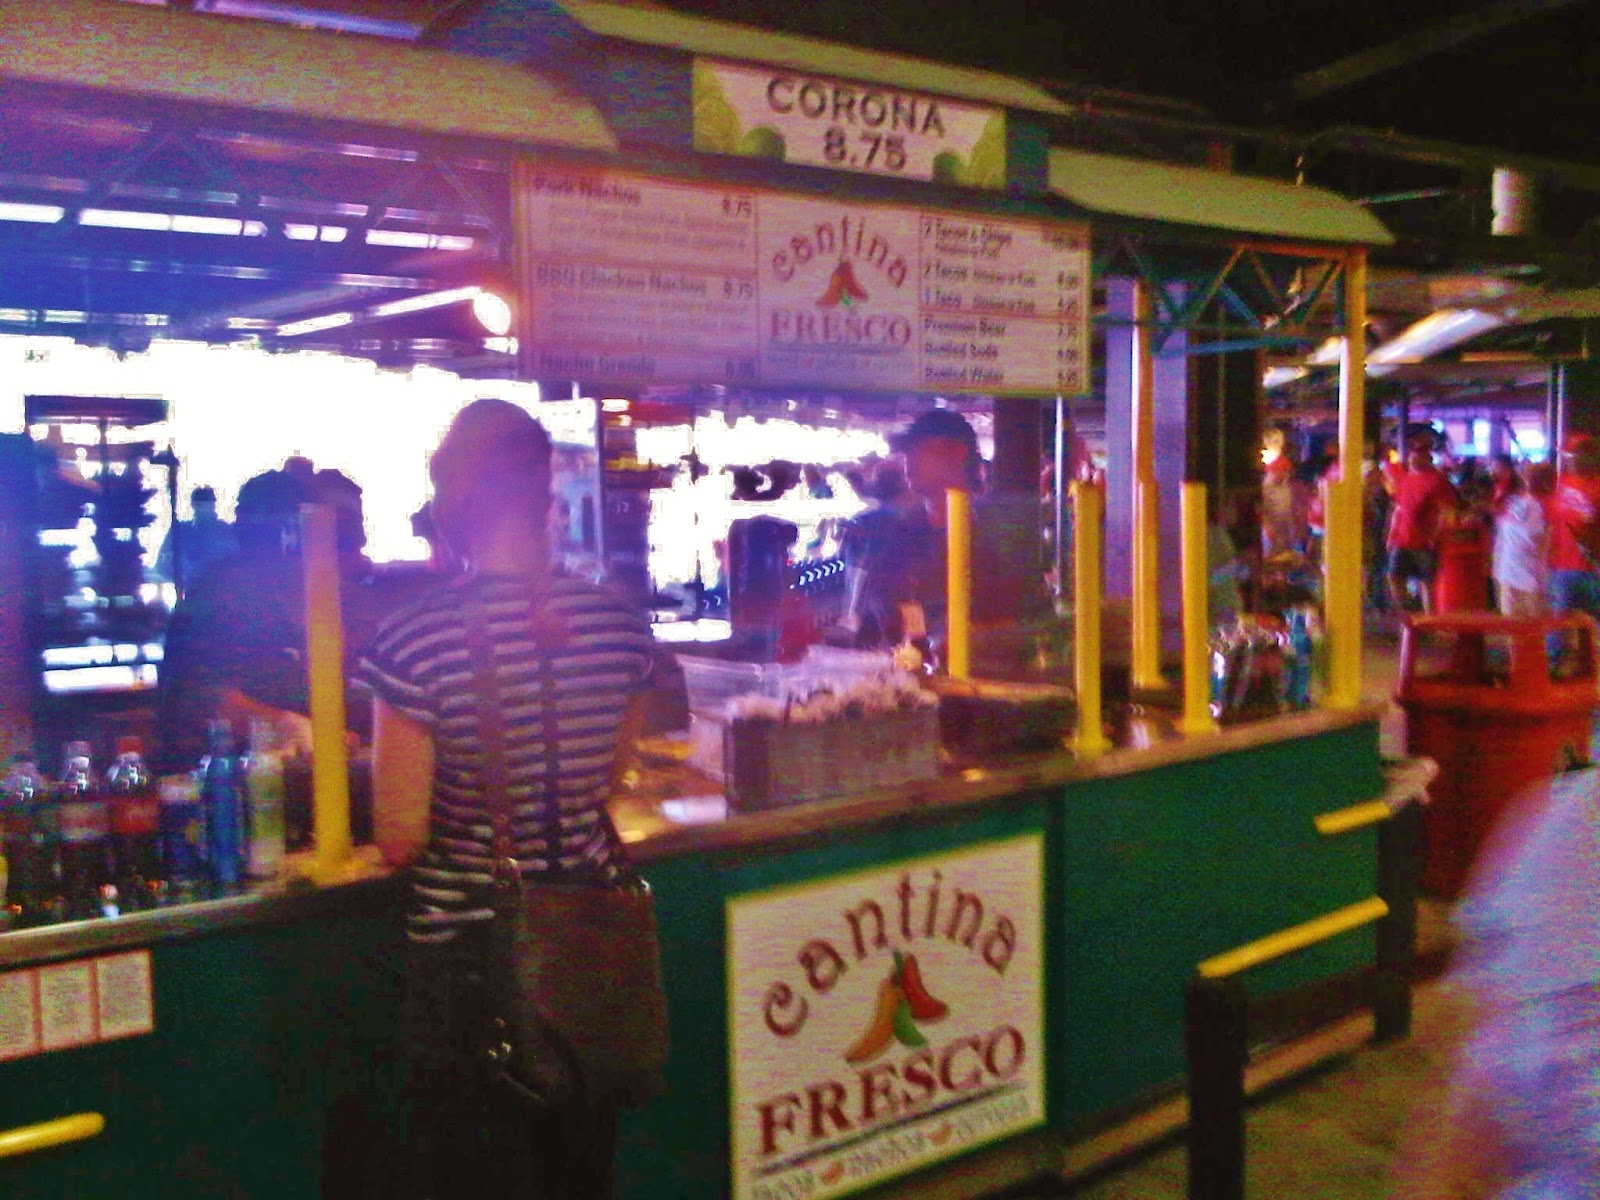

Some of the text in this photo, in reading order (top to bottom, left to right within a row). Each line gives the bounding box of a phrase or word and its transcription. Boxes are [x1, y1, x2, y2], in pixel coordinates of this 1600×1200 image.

[766, 75, 947, 139] CORONA
[823, 126, 907, 171] 8.75
[579, 267, 646, 291] Chicken
[771, 214, 909, 289] cantina
[771, 311, 912, 346] FRESCO
[762, 867, 1018, 1040] cantina
[755, 1022, 1027, 1156] FRESCO
